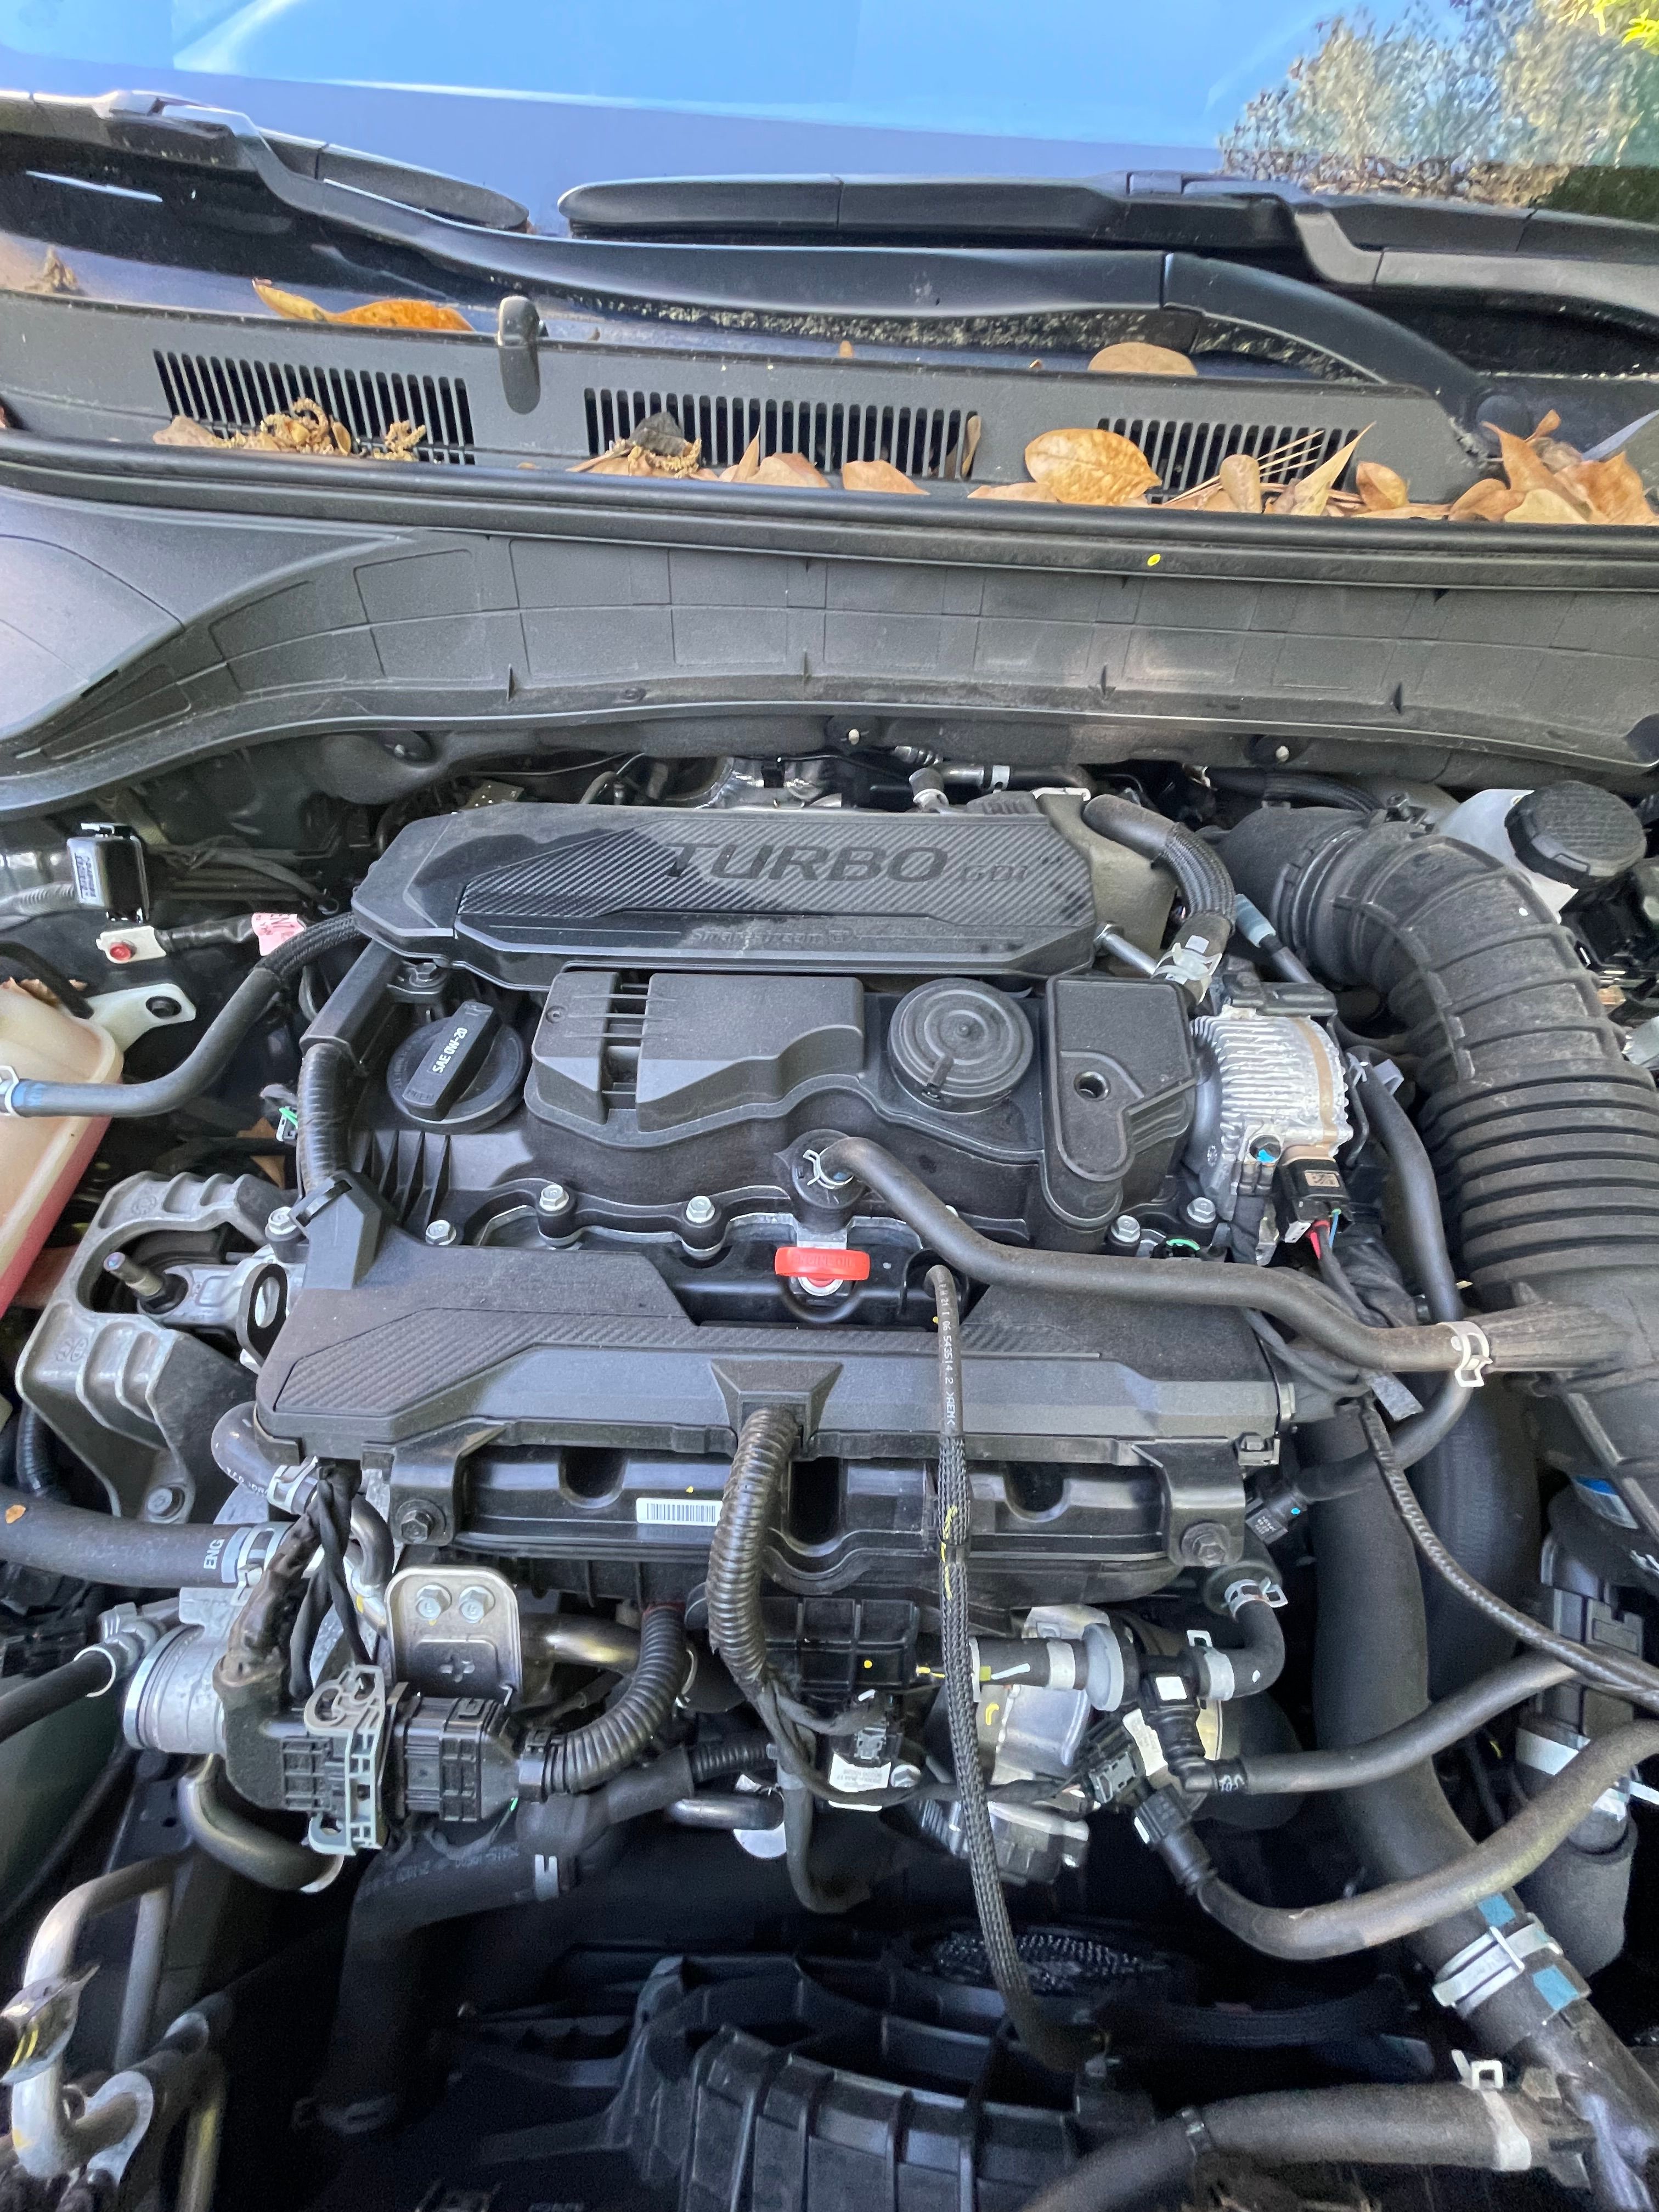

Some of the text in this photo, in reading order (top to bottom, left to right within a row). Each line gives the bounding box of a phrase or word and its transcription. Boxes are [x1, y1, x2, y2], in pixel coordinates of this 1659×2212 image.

[665, 842, 949, 883] TURBO
[432, 1026, 468, 1074] SAE 0W-20
[203, 1538, 225, 1570] ENG
